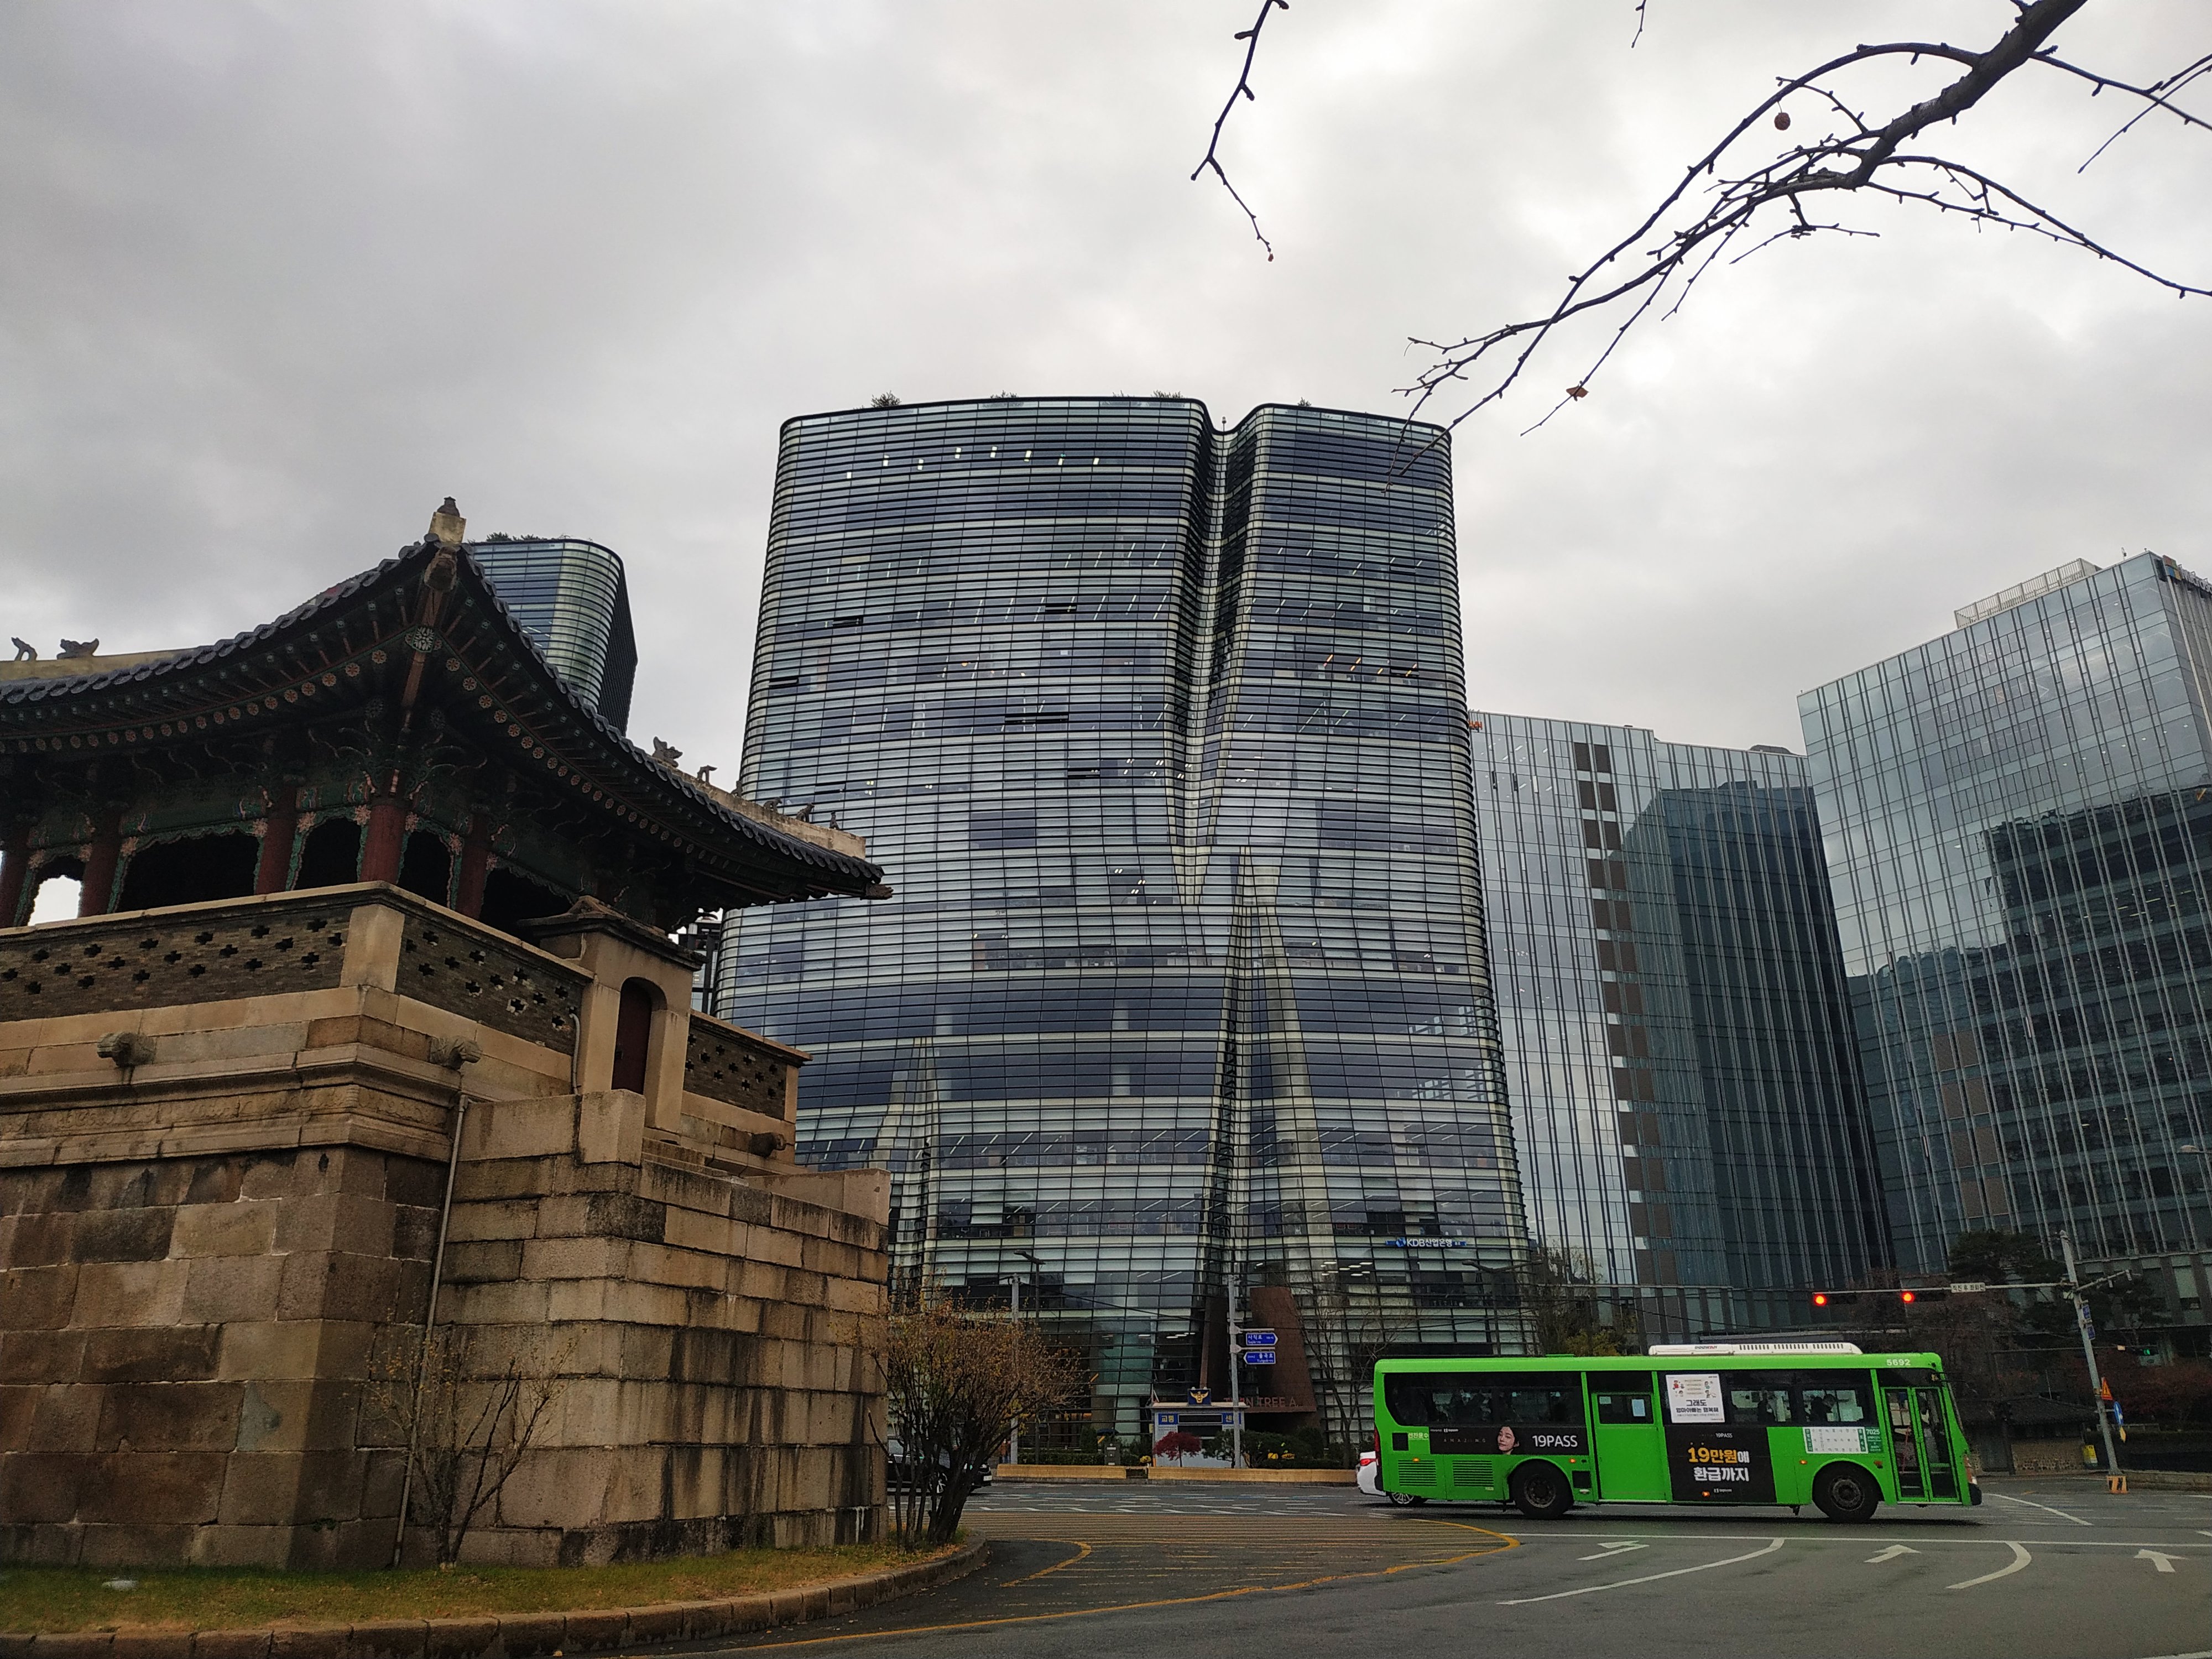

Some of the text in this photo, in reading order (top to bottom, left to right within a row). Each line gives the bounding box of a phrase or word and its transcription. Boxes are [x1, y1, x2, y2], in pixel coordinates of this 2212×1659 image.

[1407, 1238, 1452, 1248] KDB산업은행
[1258, 1397, 1285, 1407] TREE
[1532, 1435, 1578, 1447] 19PASS
[1688, 1447, 1750, 1463] 19만원에
[1693, 1467, 1749, 1481] 환급까지
